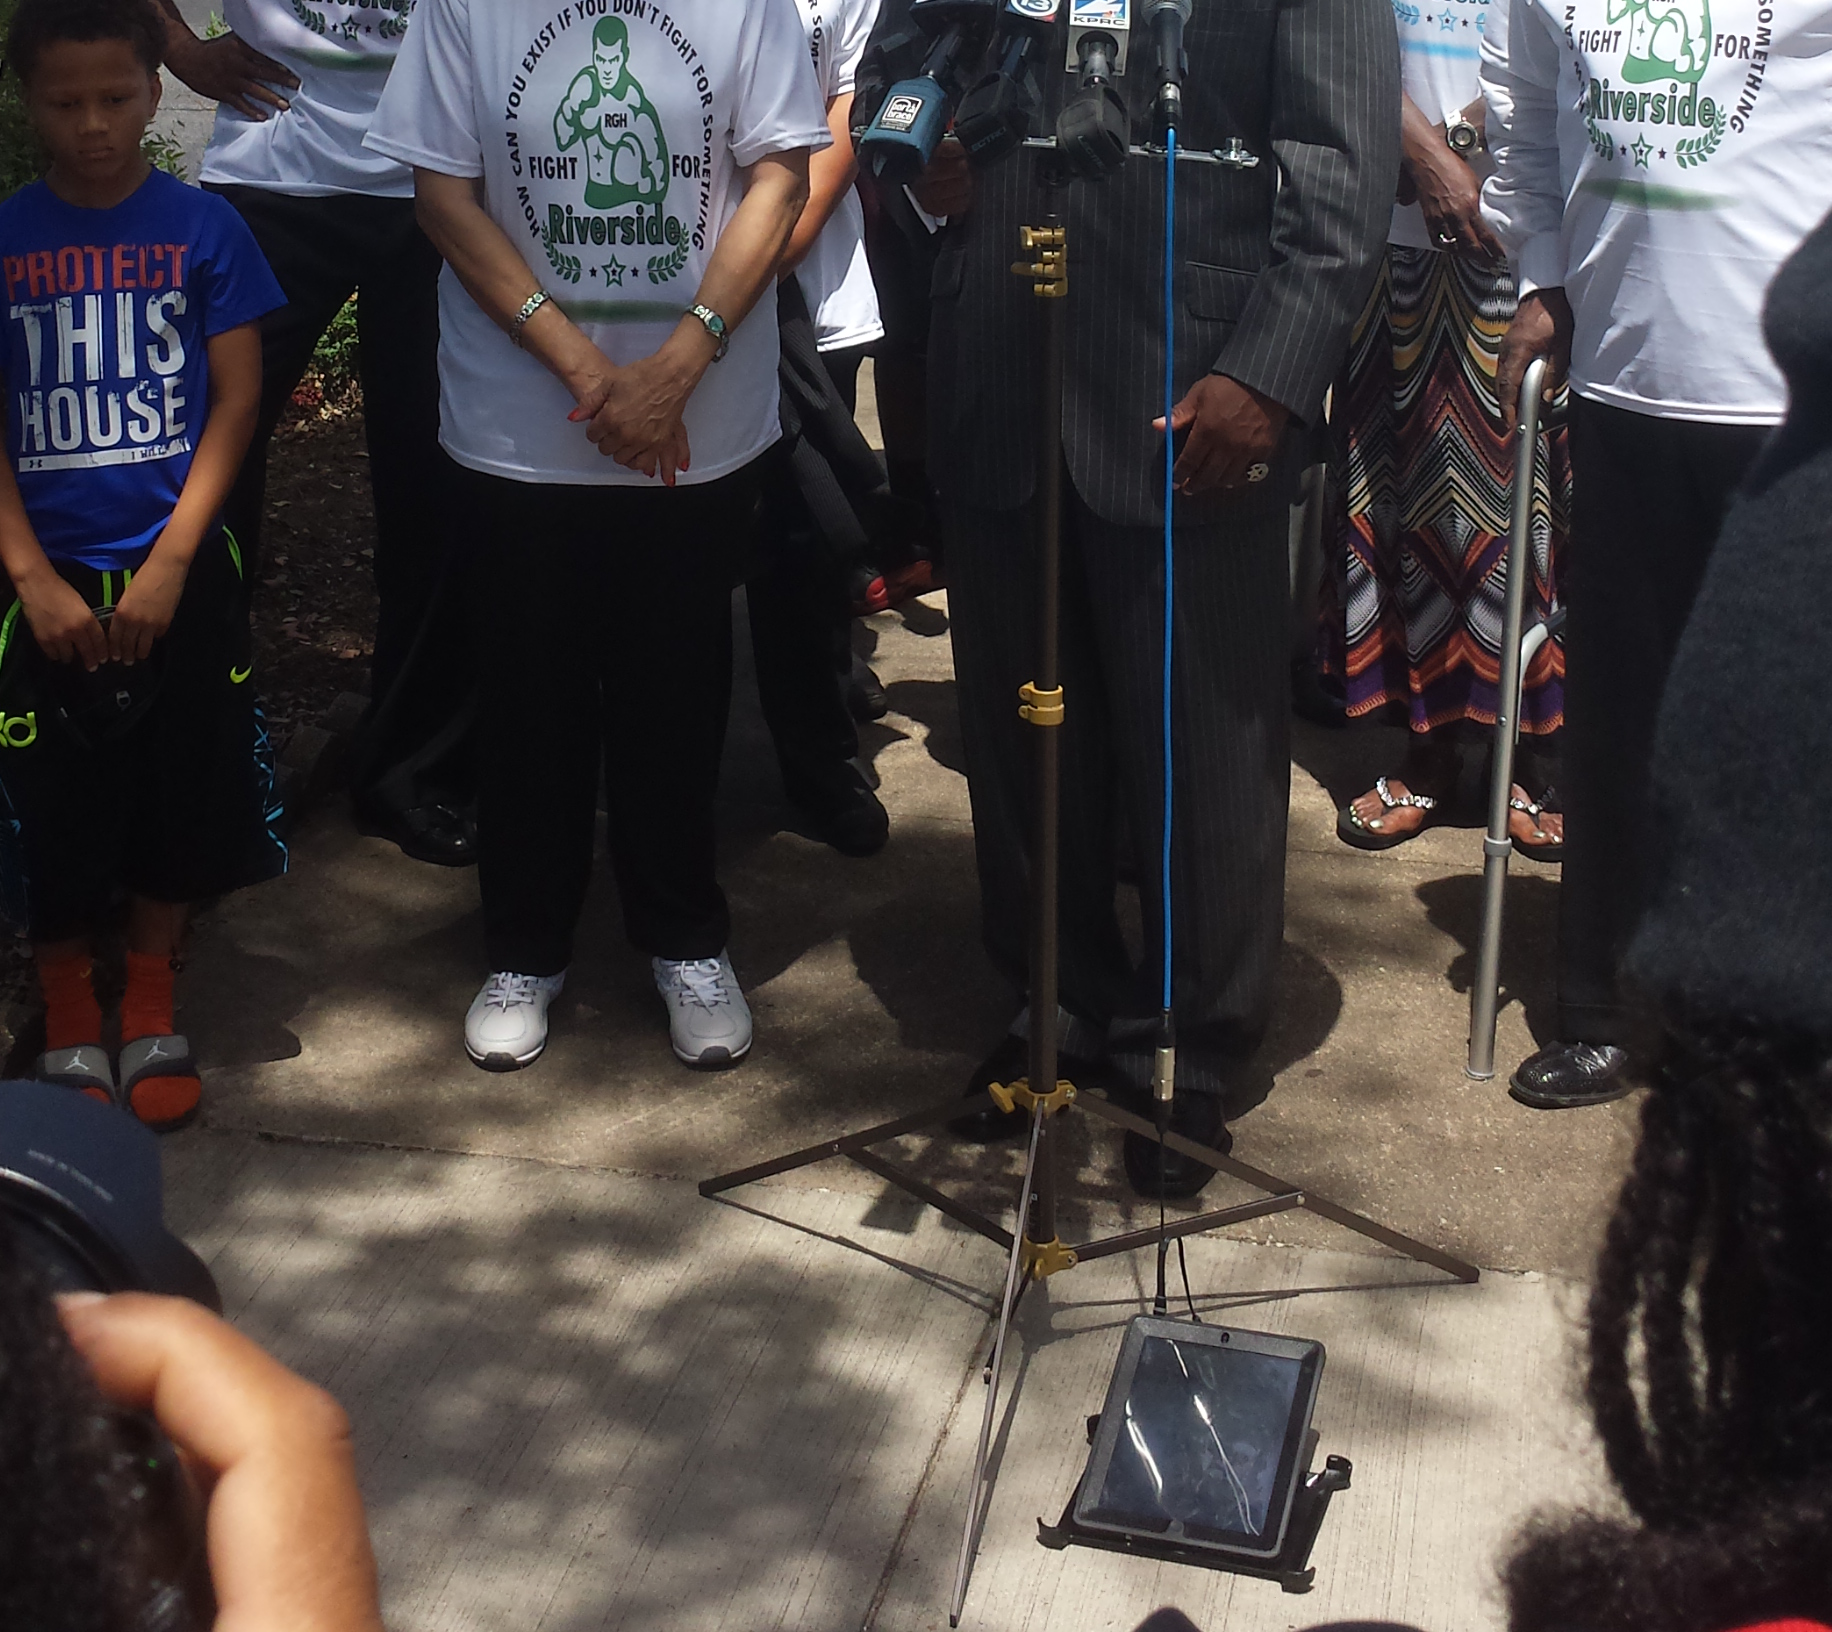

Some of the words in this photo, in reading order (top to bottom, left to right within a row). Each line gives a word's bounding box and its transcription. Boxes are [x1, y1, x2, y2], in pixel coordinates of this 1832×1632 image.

[557, 7, 573, 32] IF
[659, 14, 698, 66] FIGHT
[1073, 15, 1126, 27] KPRC
[522, 22, 557, 74] EXIST
[1579, 29, 1622, 54] FIGHT
[1713, 33, 1750, 60] FOR
[505, 74, 527, 122] YOU
[691, 64, 714, 109] FOR
[1589, 77, 1717, 128] Riverside
[604, 113, 628, 129] RGH
[505, 131, 522, 177] CAN
[528, 155, 578, 180] FIGHT
[672, 154, 701, 179] FOR
[692, 113, 714, 251] SOMETHING
[516, 185, 540, 238] HOW
[548, 202, 682, 246] Riverside
[2, 243, 189, 303] PROTECT
[10, 289, 188, 386] THIS
[18, 375, 187, 454] HOUSE
